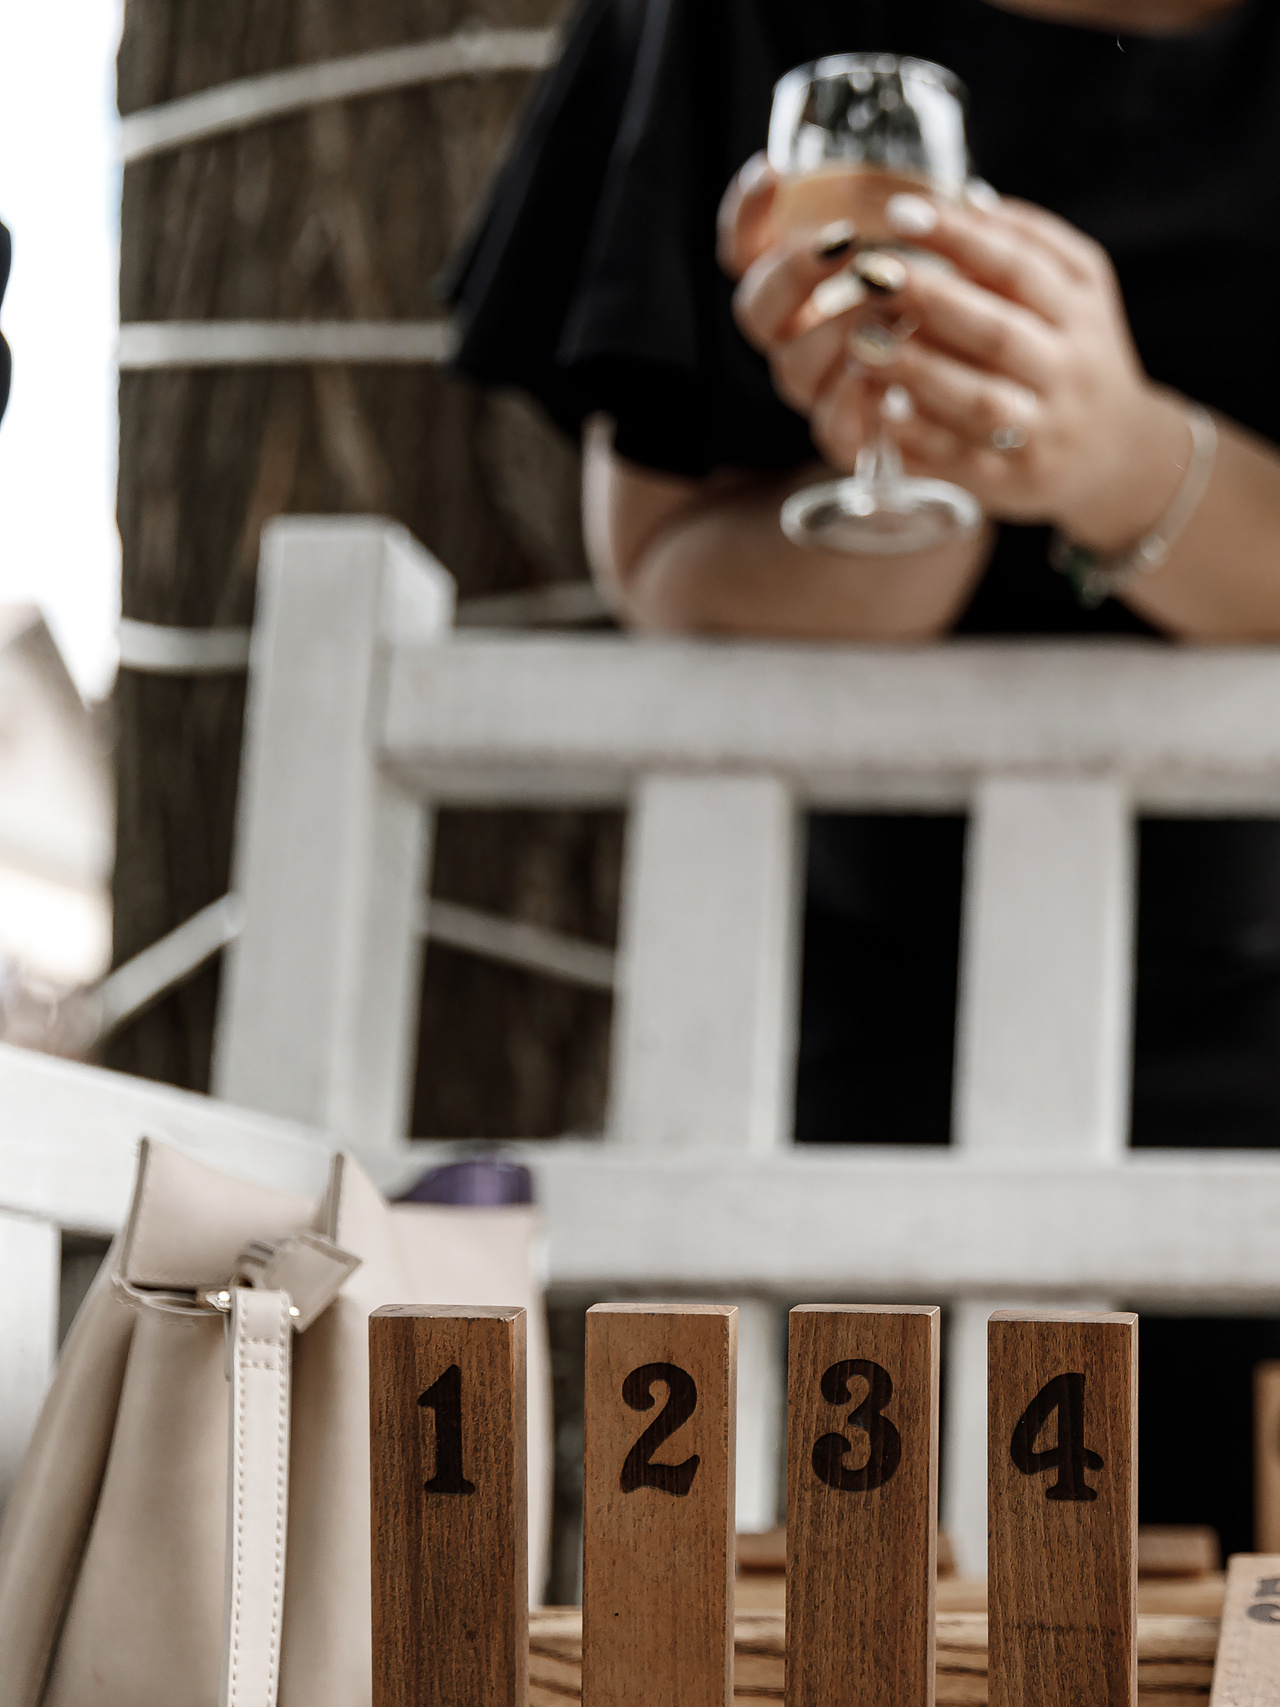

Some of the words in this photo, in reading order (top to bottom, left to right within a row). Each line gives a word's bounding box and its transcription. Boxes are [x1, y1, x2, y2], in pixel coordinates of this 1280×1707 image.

[416, 1364, 476, 1495] 1
[619, 1362, 701, 1497] 2
[811, 1359, 902, 1493] 3
[1010, 1373, 1104, 1502] 4
